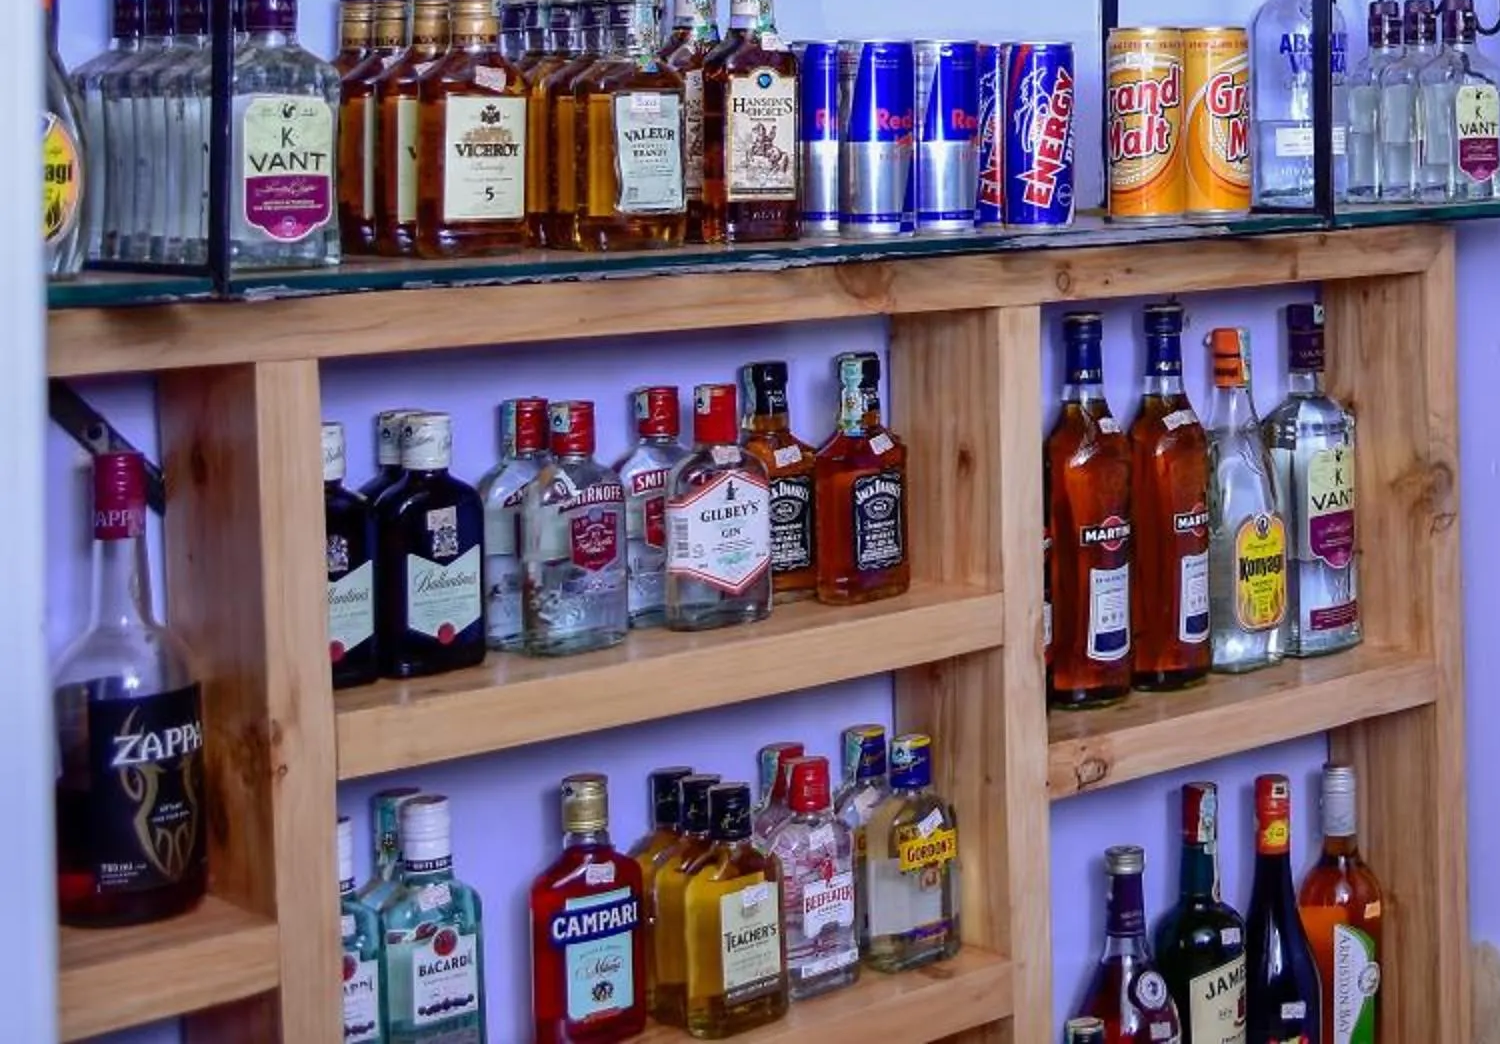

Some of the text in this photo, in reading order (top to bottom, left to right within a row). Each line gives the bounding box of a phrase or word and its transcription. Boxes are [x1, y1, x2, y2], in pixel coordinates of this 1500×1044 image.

[1110, 63, 1182, 115] rand
[282, 126, 296, 148] K
[624, 128, 675, 142] VALEUR
[1459, 122, 1498, 135] VANT
[455, 143, 520, 157] VICEROY
[249, 152, 327, 172] VANT
[485, 187, 495, 201] 5
[1335, 467, 1343, 486] K
[701, 499, 761, 523] GILBEY'S
[721, 527, 741, 538] GIN
[1085, 524, 1131, 542] MARTIN
[907, 837, 953, 863] GORDON'S
[552, 901, 638, 940] CAMPARI
[724, 924, 776, 952] TEACHER'S
[1205, 963, 1246, 1000] JAME
